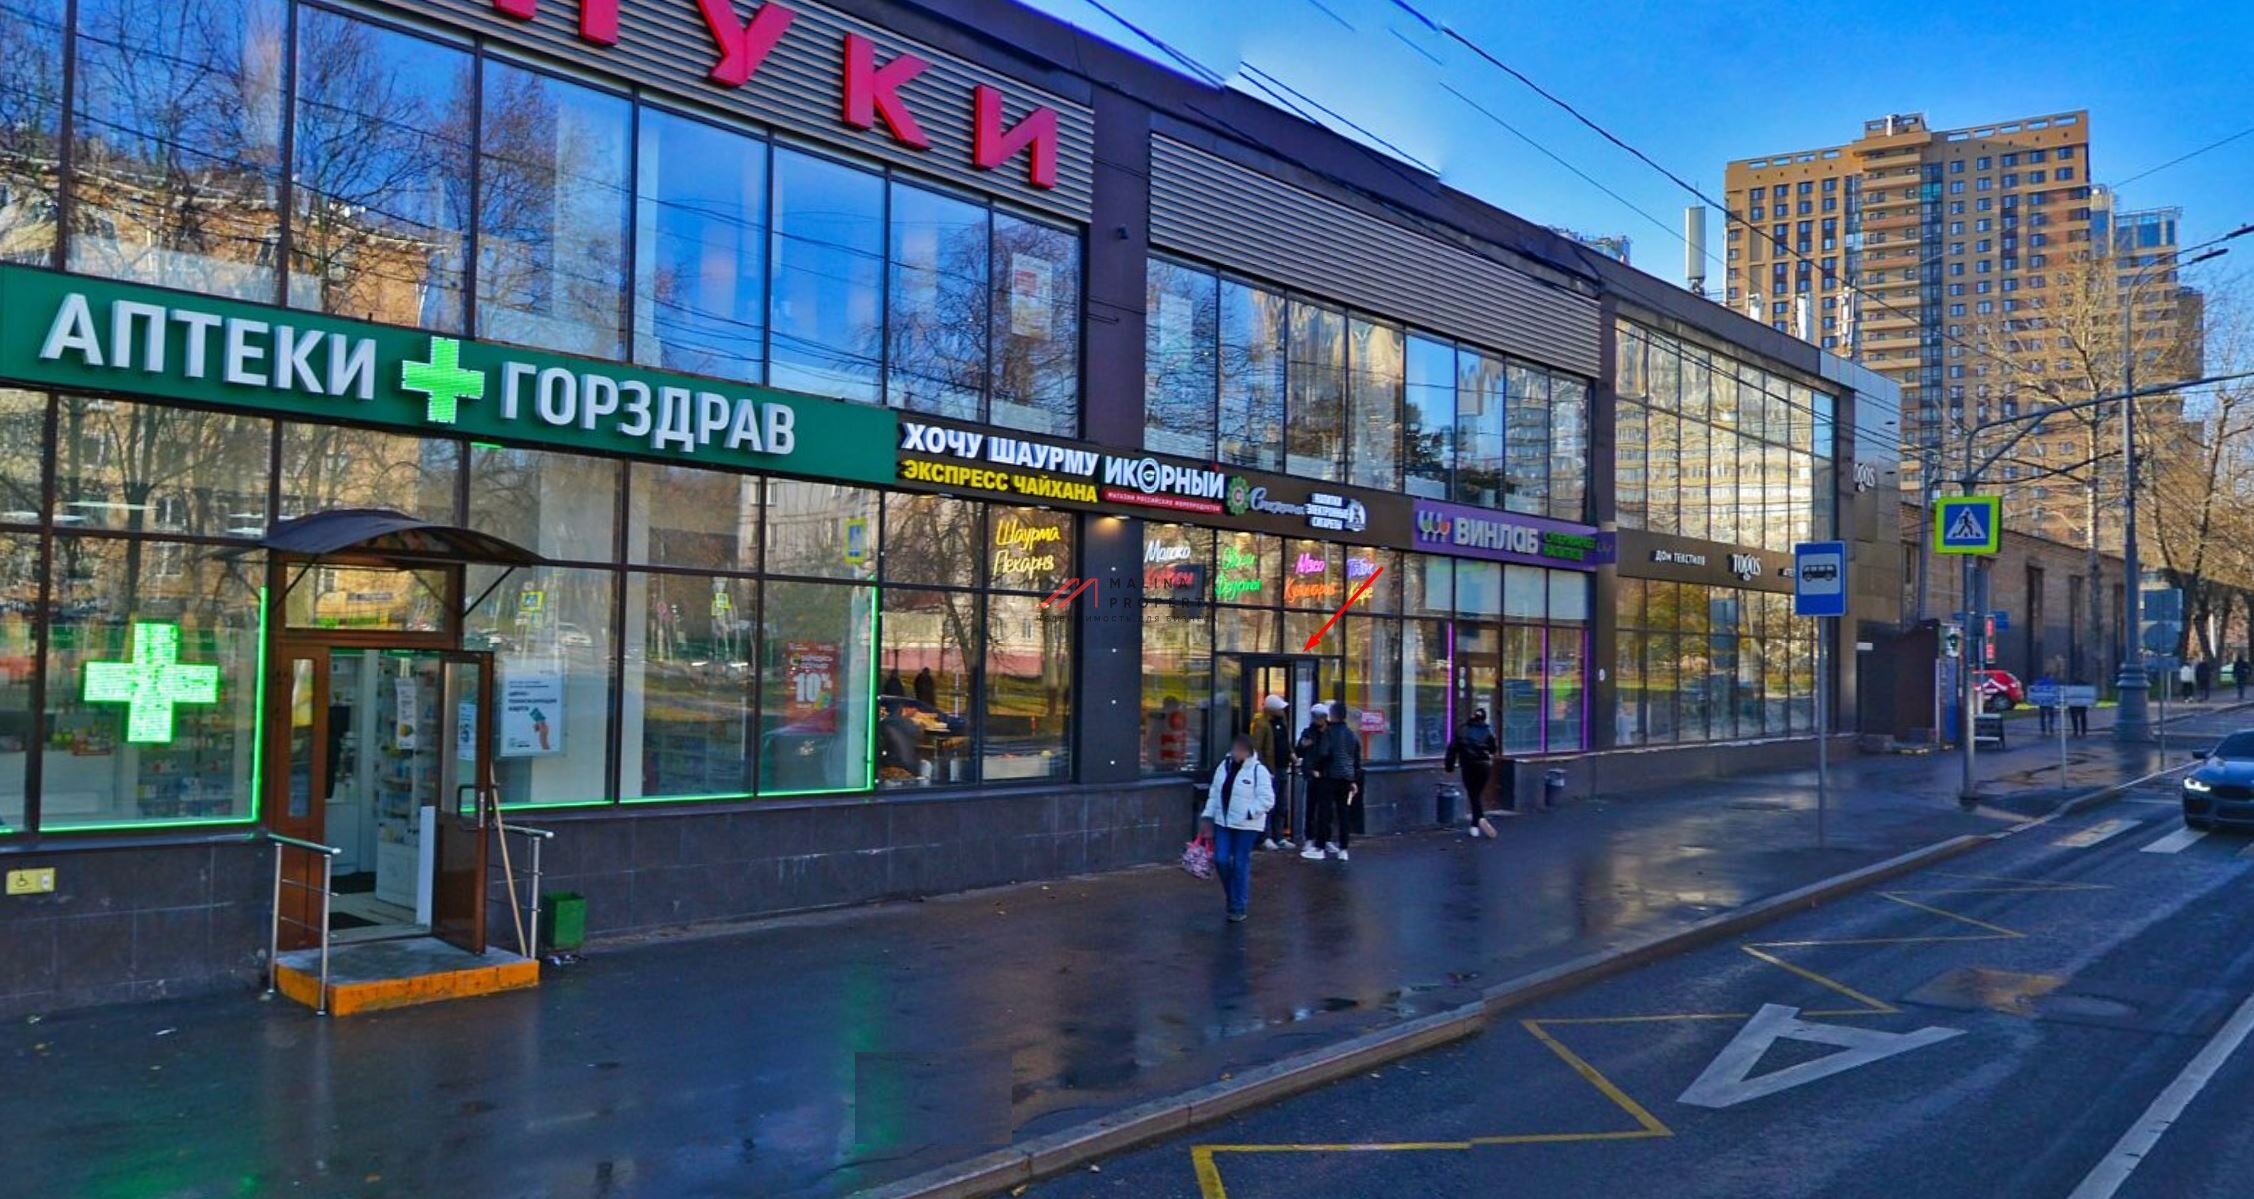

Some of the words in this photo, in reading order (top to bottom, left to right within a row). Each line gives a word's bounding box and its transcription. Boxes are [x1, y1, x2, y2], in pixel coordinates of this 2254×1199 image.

[40, 293, 377, 400] АПТЕКИ
[501, 361, 796, 456] ГОРЗДРАВ
[902, 423, 983, 459] ХОЧУ
[988, 435, 1099, 476] ШАУРМУ
[903, 459, 1009, 492] ЭКСПРЕСС
[1014, 475, 1098, 503] ЧАЙХАНА
[1105, 455, 1224, 499] ИКОРНЫЙ
[996, 517, 1060, 550] Шаурма
[1144, 540, 1191, 562] Молоко
[1454, 517, 1539, 554] ВИНЛАБ
[993, 549, 1054, 579] Пекарня
[1295, 552, 1325, 575] Мясо
